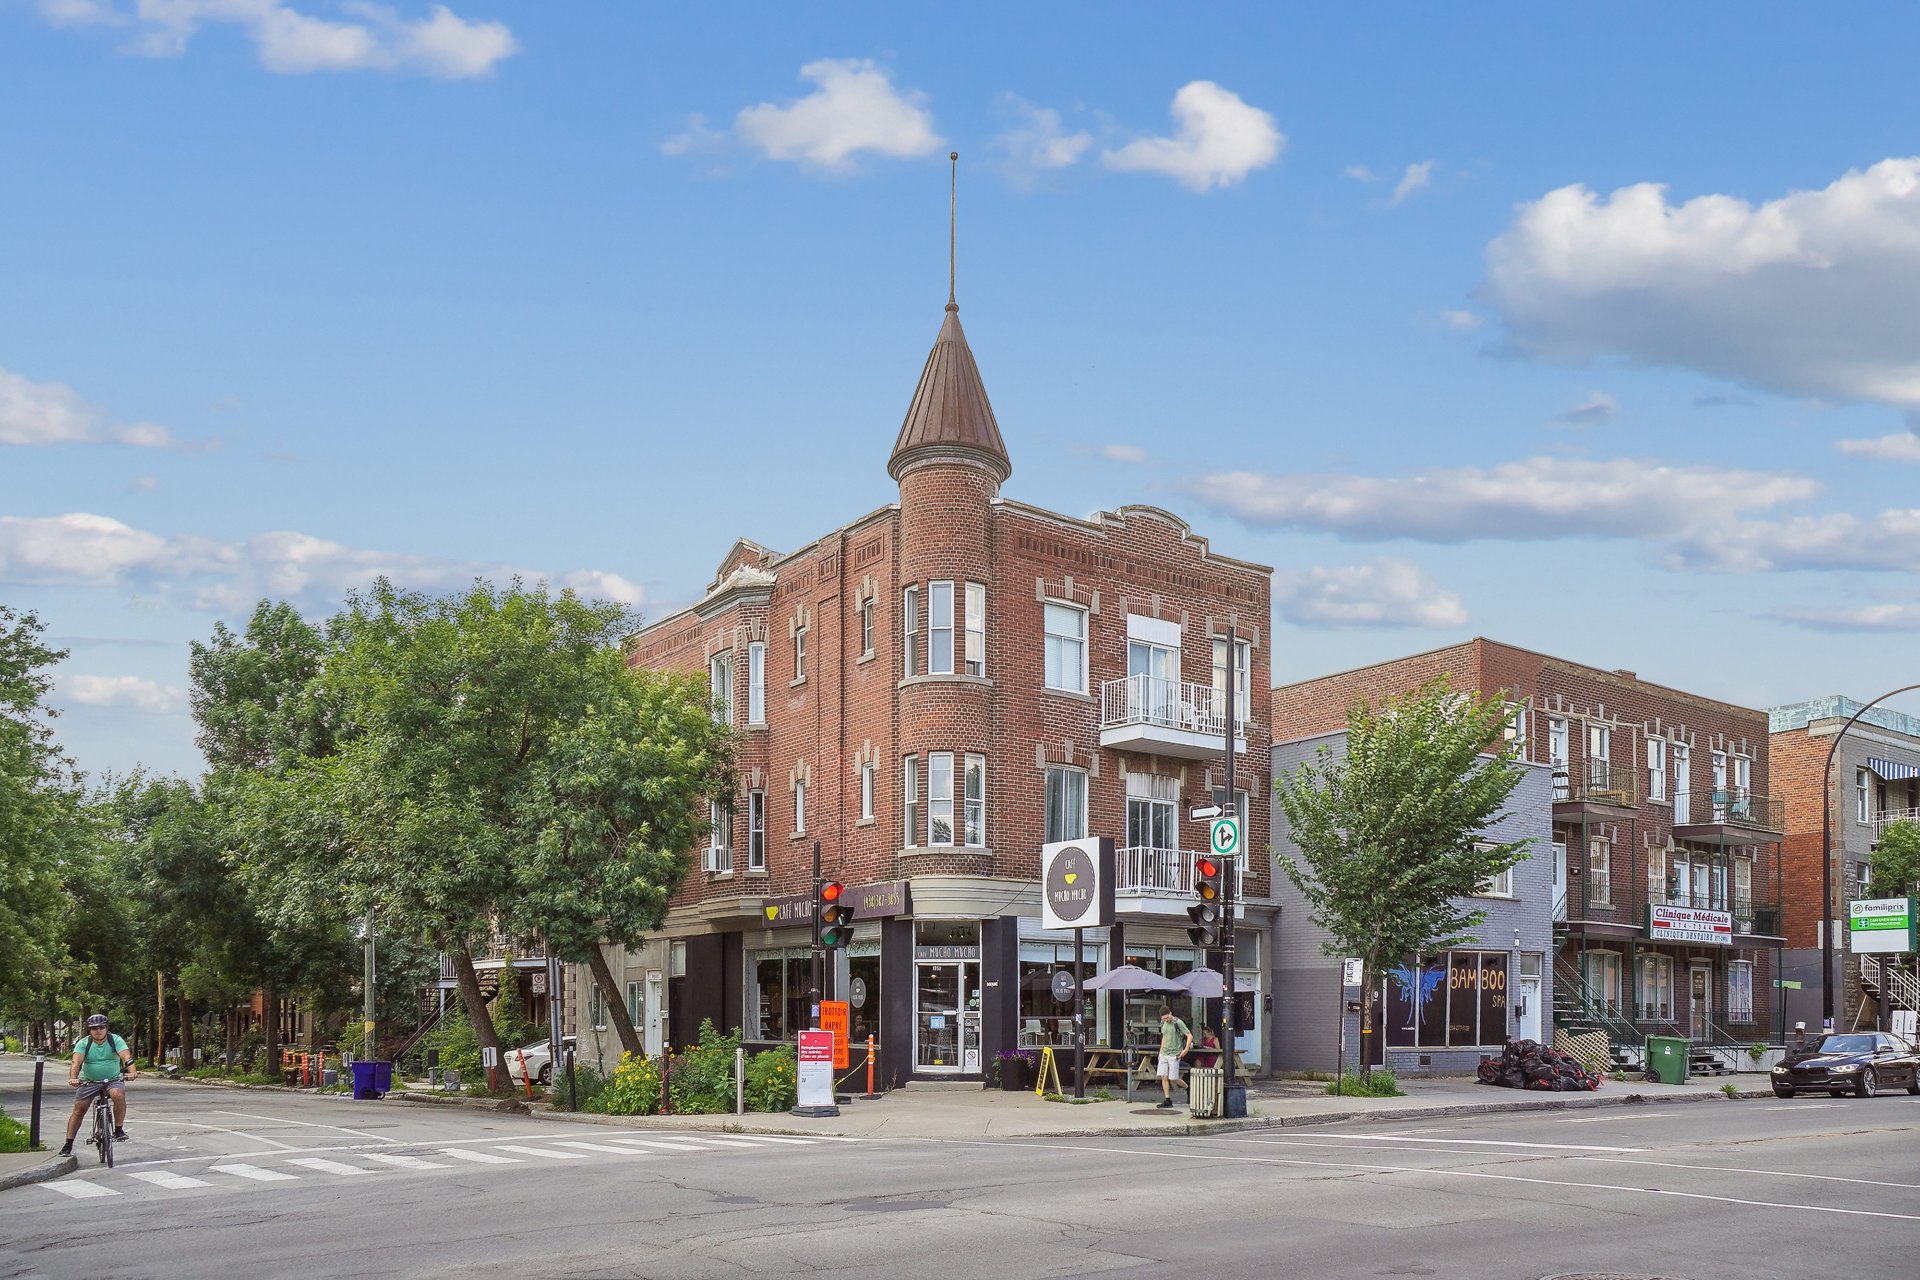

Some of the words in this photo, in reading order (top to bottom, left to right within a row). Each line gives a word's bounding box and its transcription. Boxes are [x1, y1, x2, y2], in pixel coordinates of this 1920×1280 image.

[779, 901, 793, 919] CAFÉ
[794, 900, 812, 918] MUCHO
[1865, 904, 1904, 912] familiprix
[1655, 908, 1691, 921] Clinique
[1693, 911, 1729, 923] Médicale
[929, 947, 951, 957] MUCHO
[954, 947, 976, 957] MUCHO
[1491, 995, 1506, 1008] SPA
[822, 1006, 847, 1016] TROTTOIR
